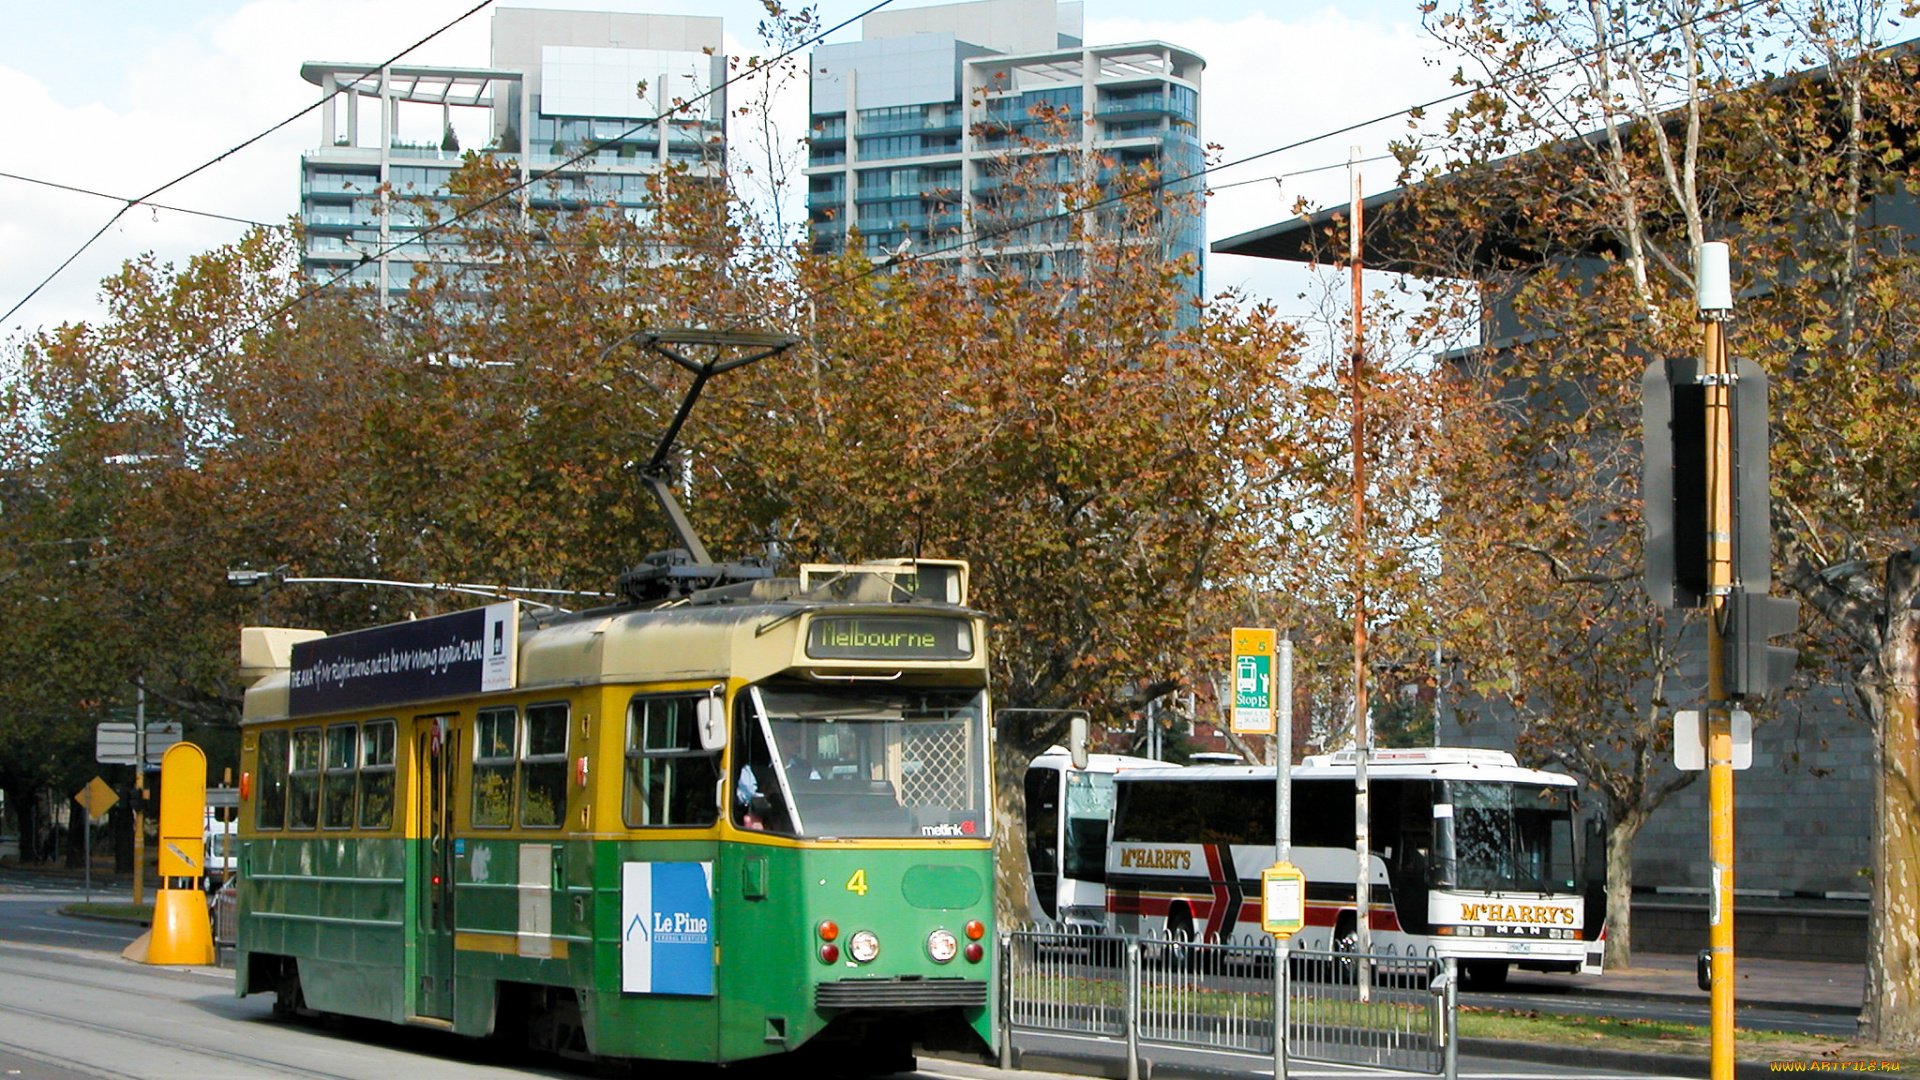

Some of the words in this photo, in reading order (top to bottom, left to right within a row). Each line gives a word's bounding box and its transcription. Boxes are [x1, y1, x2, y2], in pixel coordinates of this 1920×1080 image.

[822, 620, 936, 647] Melbourne
[291, 669, 301, 689] THE
[301, 666, 314, 687] AXA
[321, 662, 333, 682] Mr
[331, 655, 351, 688] Right
[350, 657, 371, 678] turns
[370, 652, 383, 676] out
[382, 652, 390, 673] to
[390, 647, 399, 673] be
[399, 650, 412, 671] Mr
[411, 648, 438, 675] Wrong
[1237, 694, 1257, 707] Stop
[1258, 695, 1268, 707] 15
[922, 823, 963, 836] metlink
[847, 869, 867, 896] 4
[654, 912, 673, 932] Le
[673, 912, 708, 933] Pine
[1497, 926, 1540, 934] MAN
